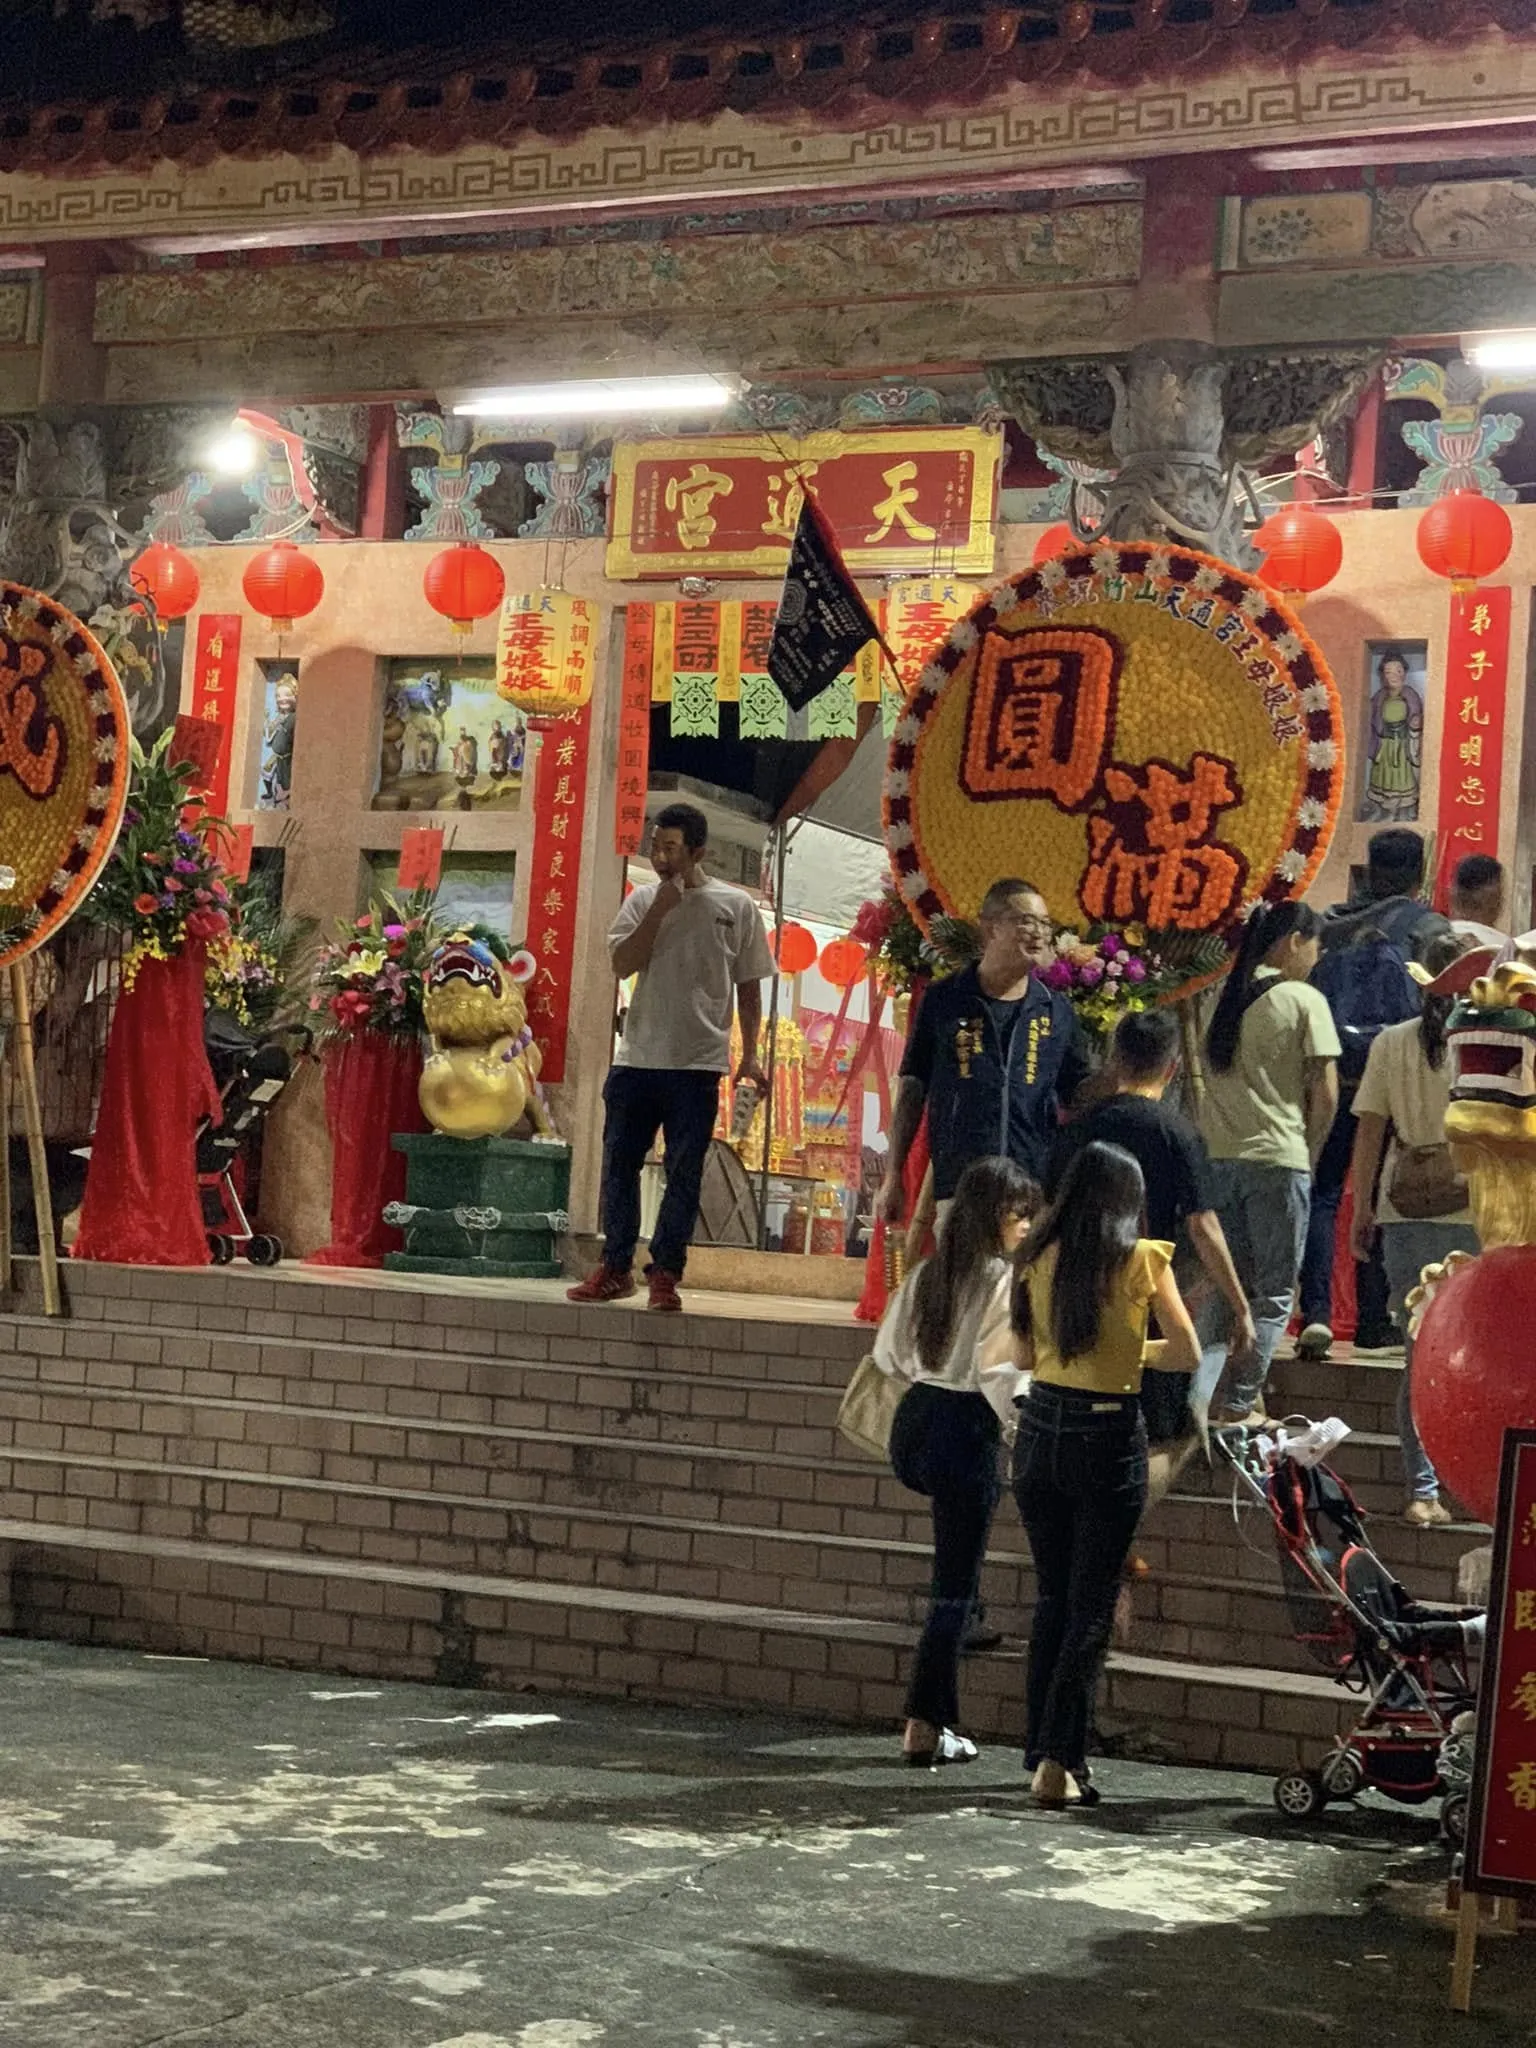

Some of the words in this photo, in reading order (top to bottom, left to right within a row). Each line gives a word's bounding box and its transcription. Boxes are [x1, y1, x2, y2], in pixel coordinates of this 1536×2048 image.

[501, 612, 558, 691] 王母娘娘
[563, 599, 592, 696] 風調雨順
[959, 624, 1244, 933] 圓滿
